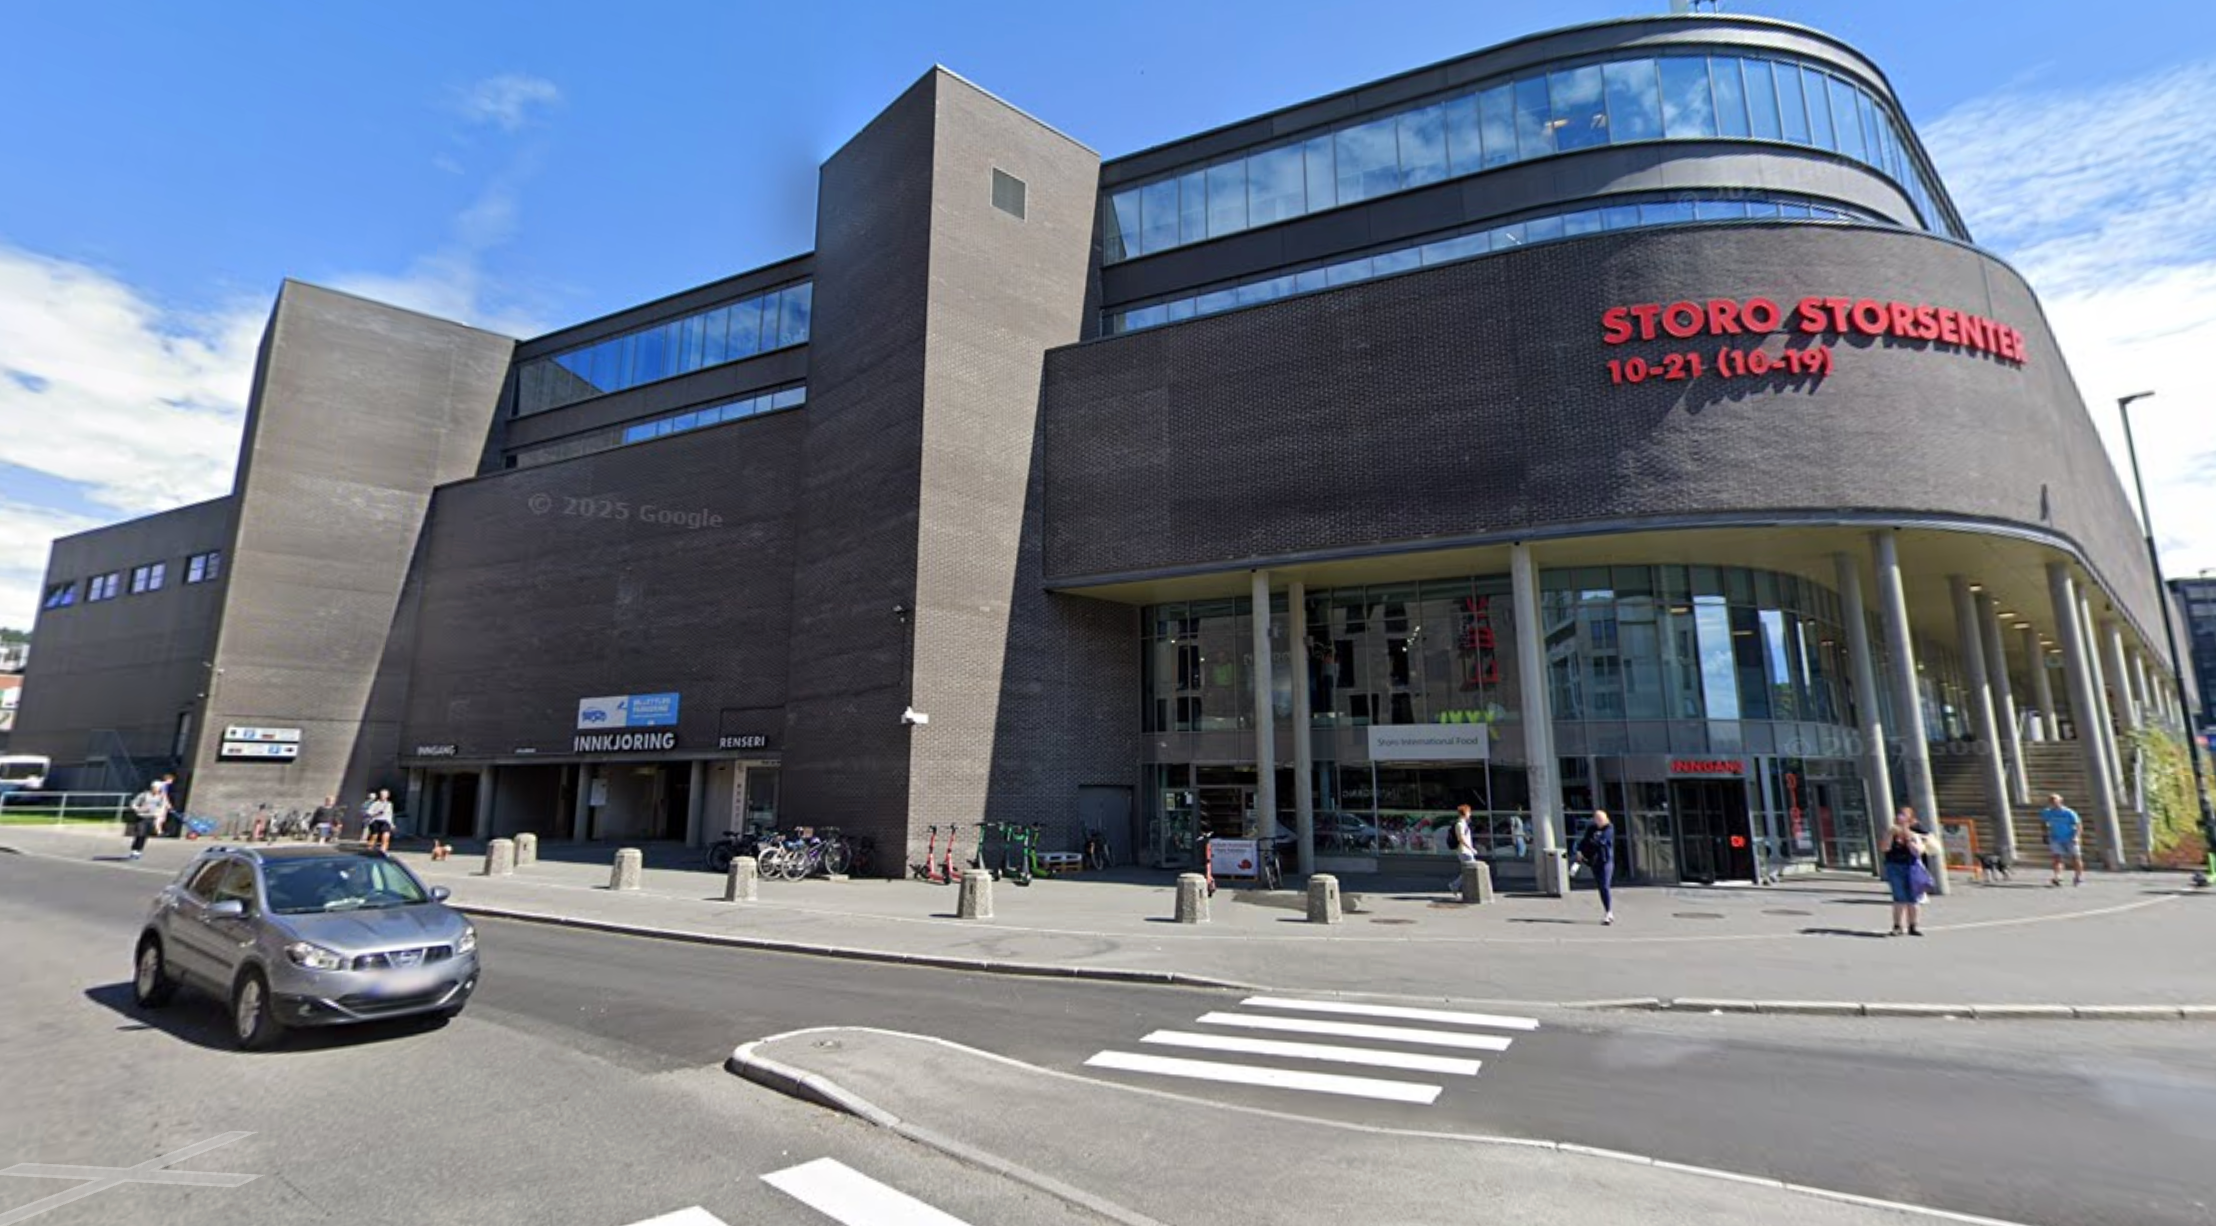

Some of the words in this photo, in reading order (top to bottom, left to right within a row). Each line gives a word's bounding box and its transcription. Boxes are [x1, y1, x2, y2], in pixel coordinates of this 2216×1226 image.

[1603, 297, 1781, 344] STORO
[1799, 295, 2026, 363] STORSENTER
[1608, 352, 1703, 384] 10-21
[1718, 345, 1833, 378] (10-19)
[720, 736, 765, 749] RENSERI
[1401, 736, 1454, 745] International
[1456, 736, 1478, 745] Food
